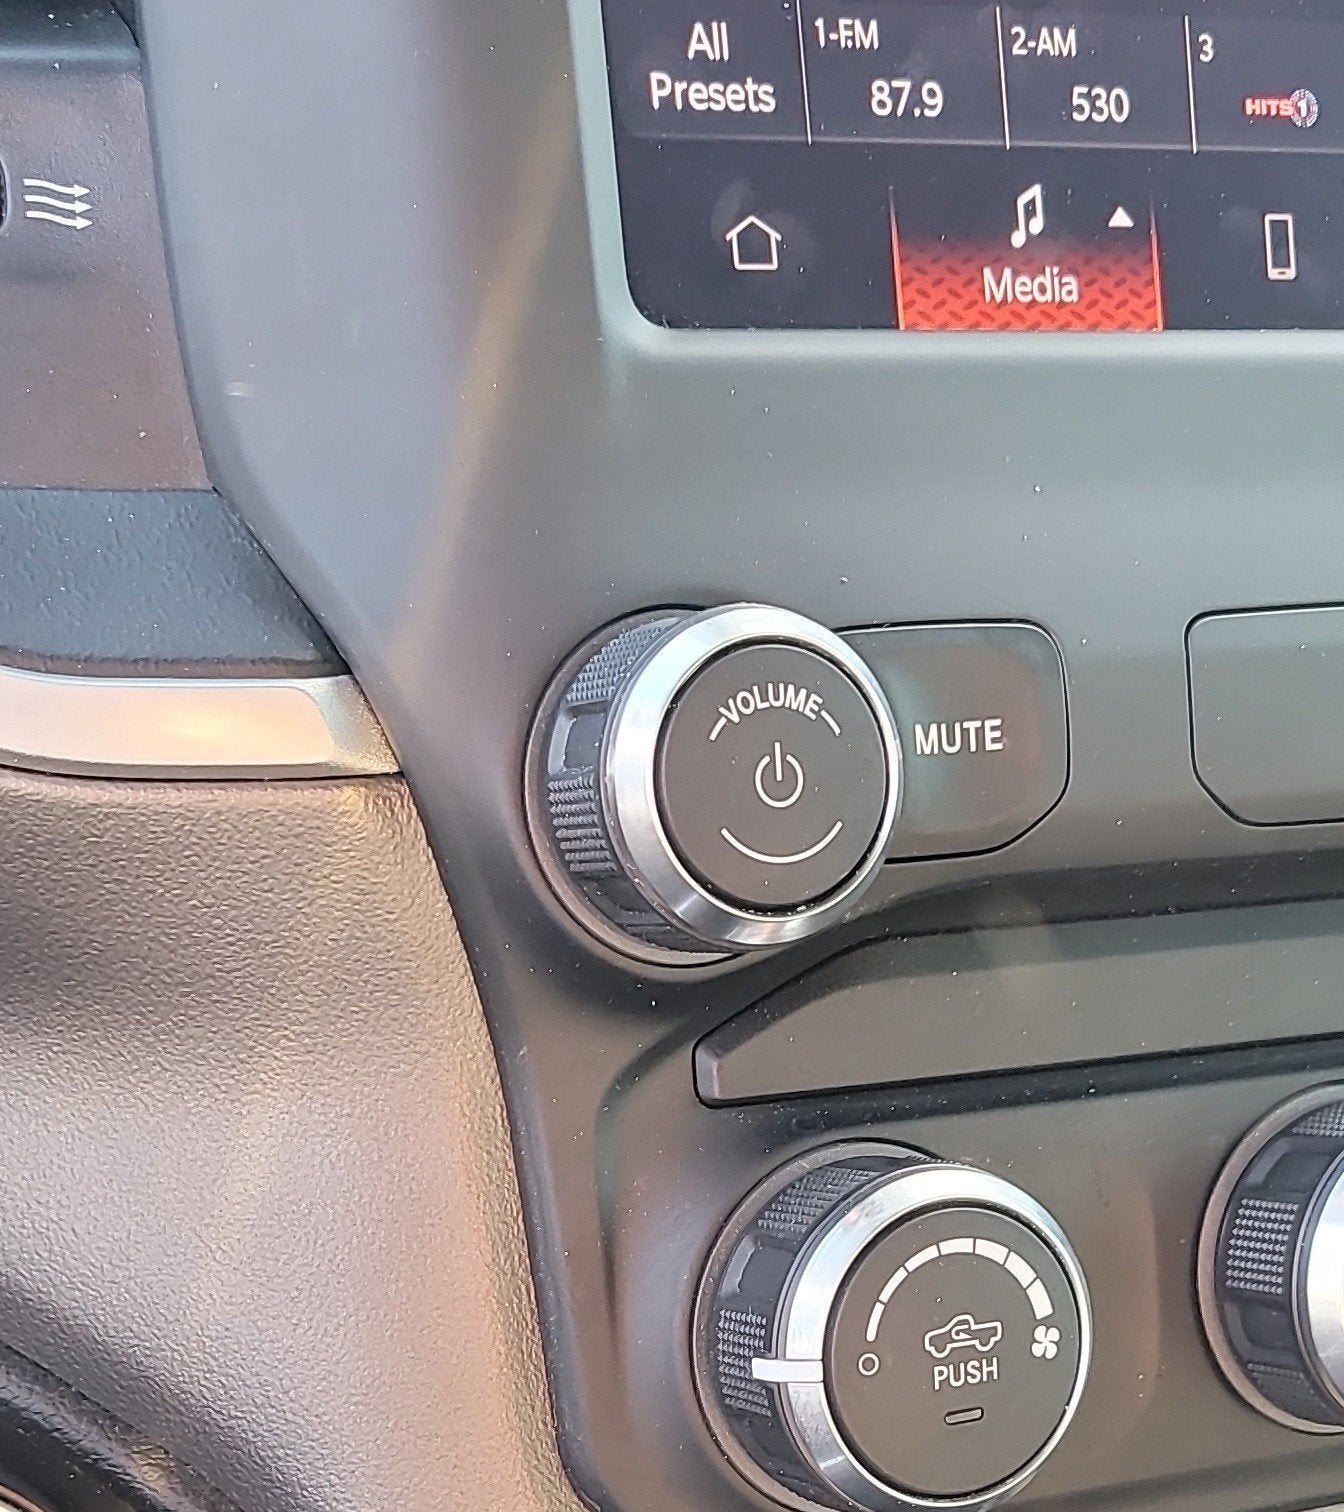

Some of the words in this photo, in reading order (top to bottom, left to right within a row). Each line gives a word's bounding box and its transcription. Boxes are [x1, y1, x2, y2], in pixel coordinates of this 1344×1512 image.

[687, 21, 729, 62] All
[814, 18, 879, 50] 1-FM
[1010, 27, 1077, 57] 2-AM
[1198, 34, 1214, 62] 3
[648, 71, 776, 114] Presets
[870, 79, 944, 118] 87.9
[1071, 86, 1130, 123] 530
[983, 266, 1079, 304] Media
[718, 682, 823, 724] VOLUME
[914, 718, 1005, 756] MUTE
[934, 1357, 999, 1391] PUSH
